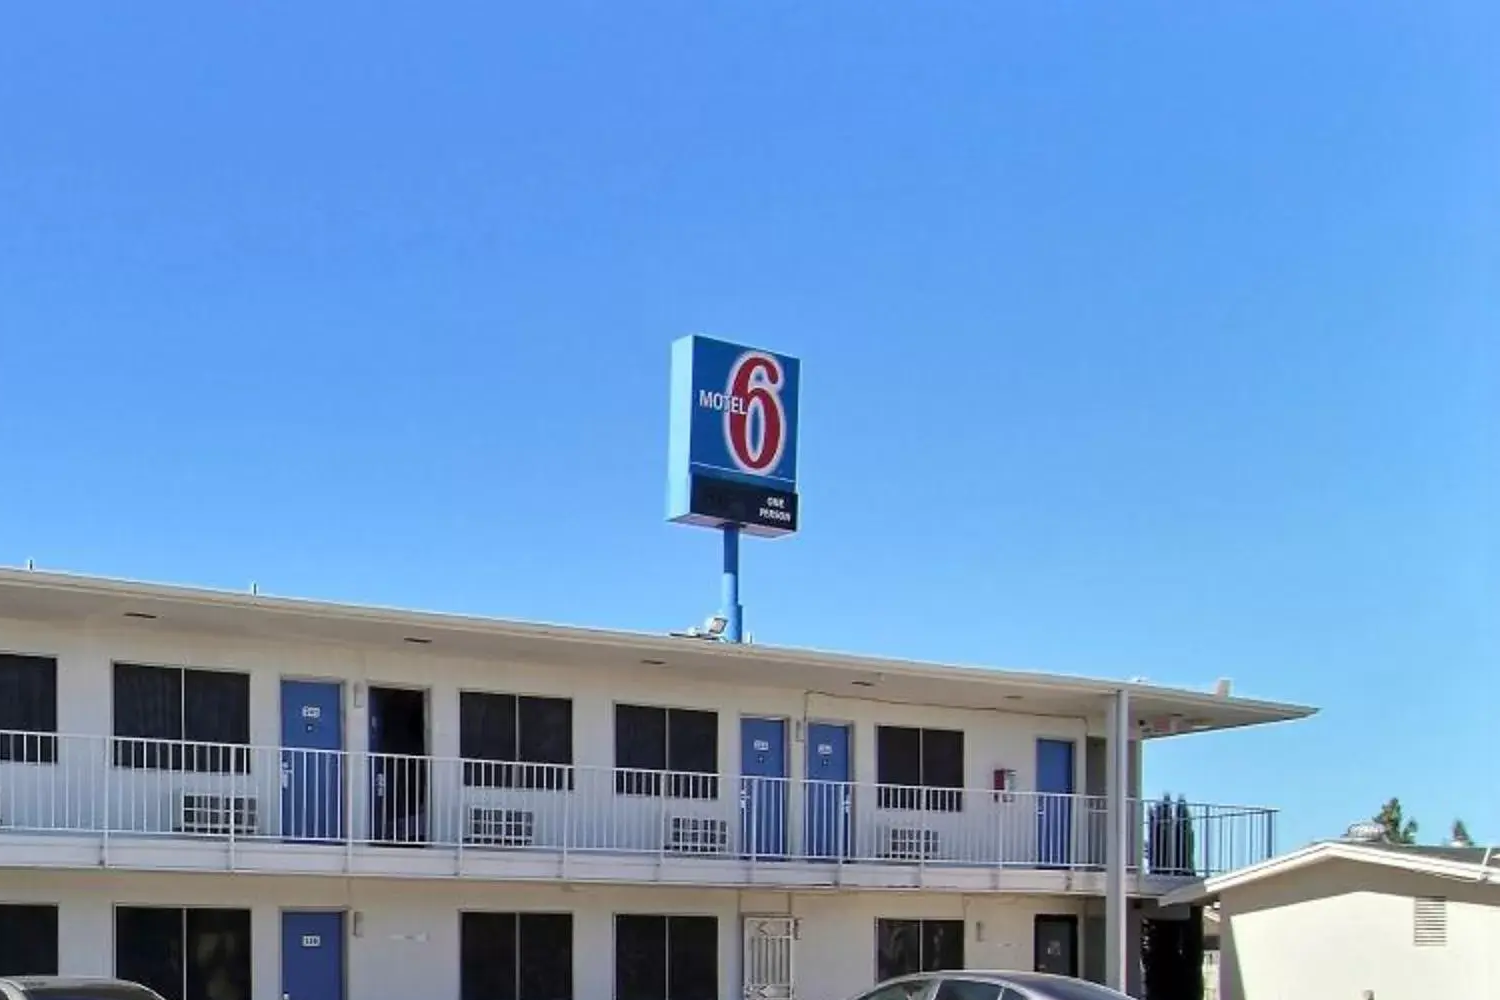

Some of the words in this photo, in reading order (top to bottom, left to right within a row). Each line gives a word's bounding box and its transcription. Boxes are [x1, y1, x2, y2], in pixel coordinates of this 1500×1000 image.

[699, 389, 747, 415] MOTEL
[727, 354, 783, 472] 6
[759, 507, 791, 522] PERSON
